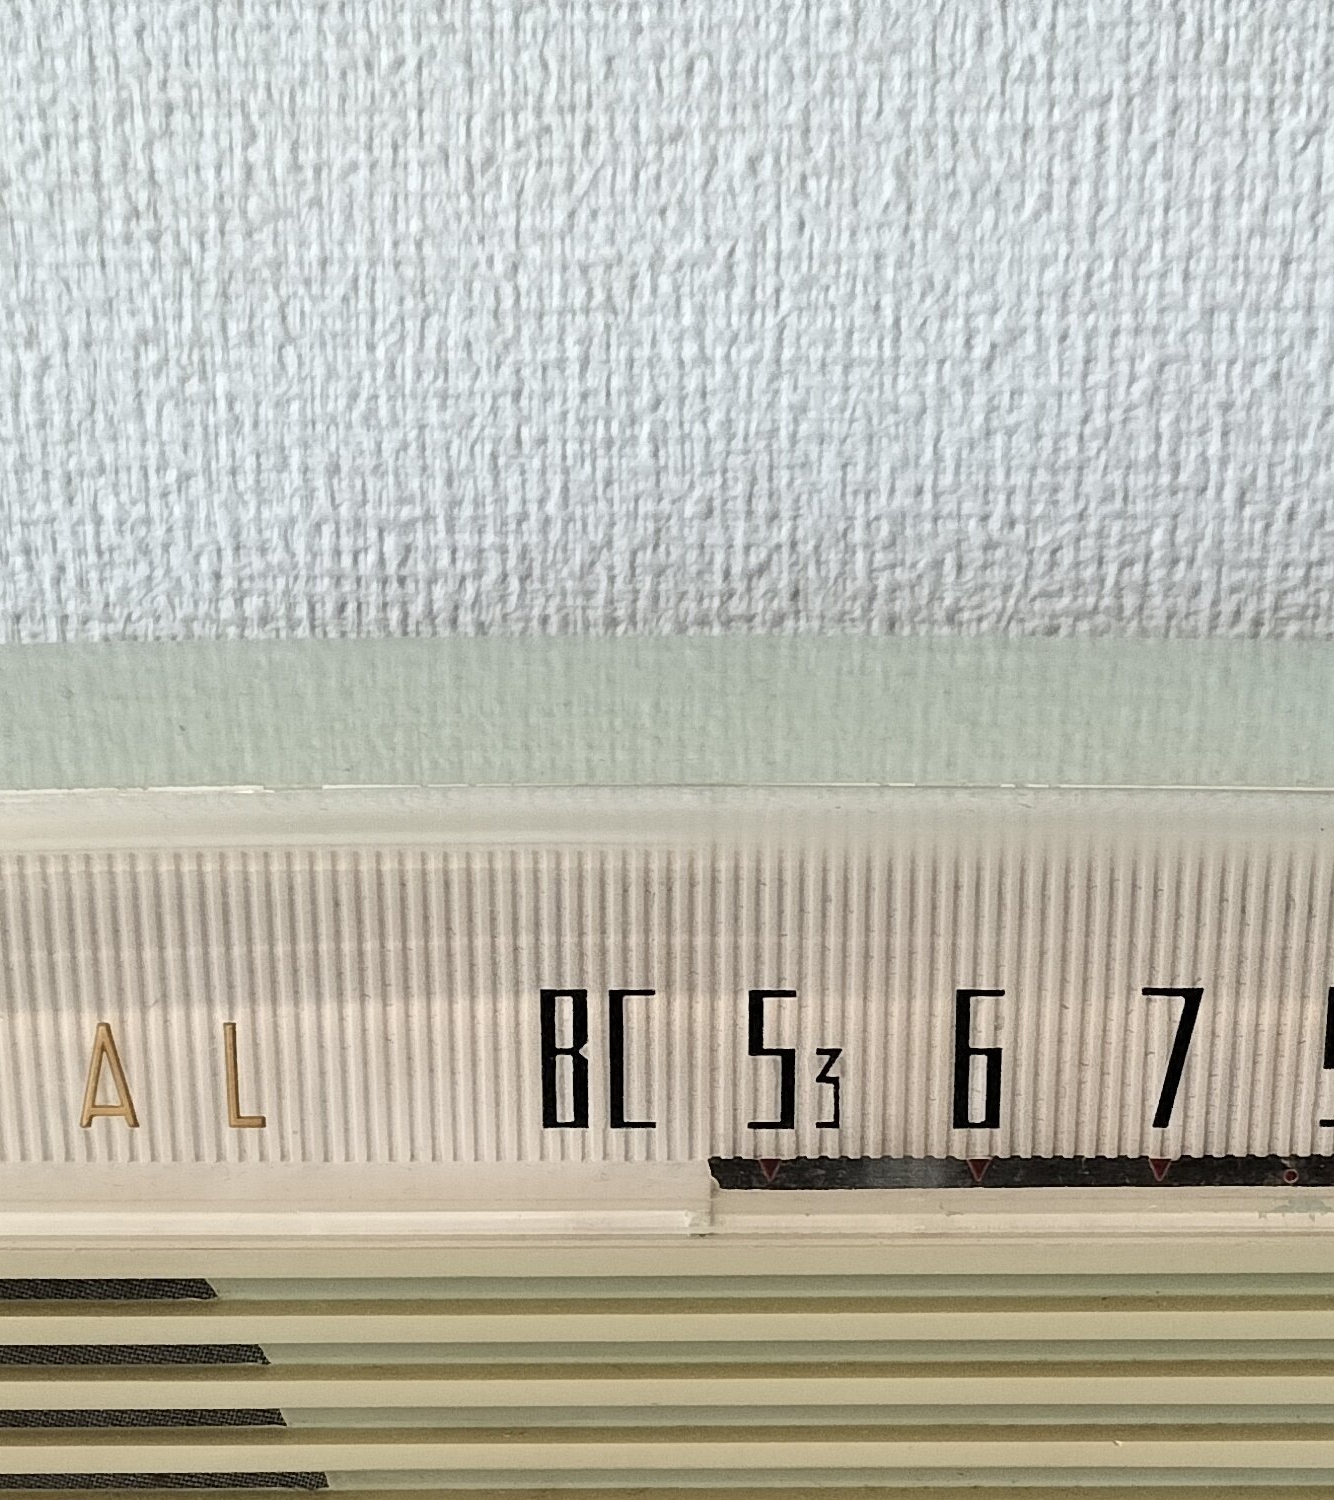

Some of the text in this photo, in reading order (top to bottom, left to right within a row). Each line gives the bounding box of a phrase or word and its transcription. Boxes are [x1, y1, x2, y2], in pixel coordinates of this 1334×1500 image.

[539, 988, 657, 1130] BC
[952, 989, 1006, 1130] 6
[1141, 987, 1205, 1129] 7
